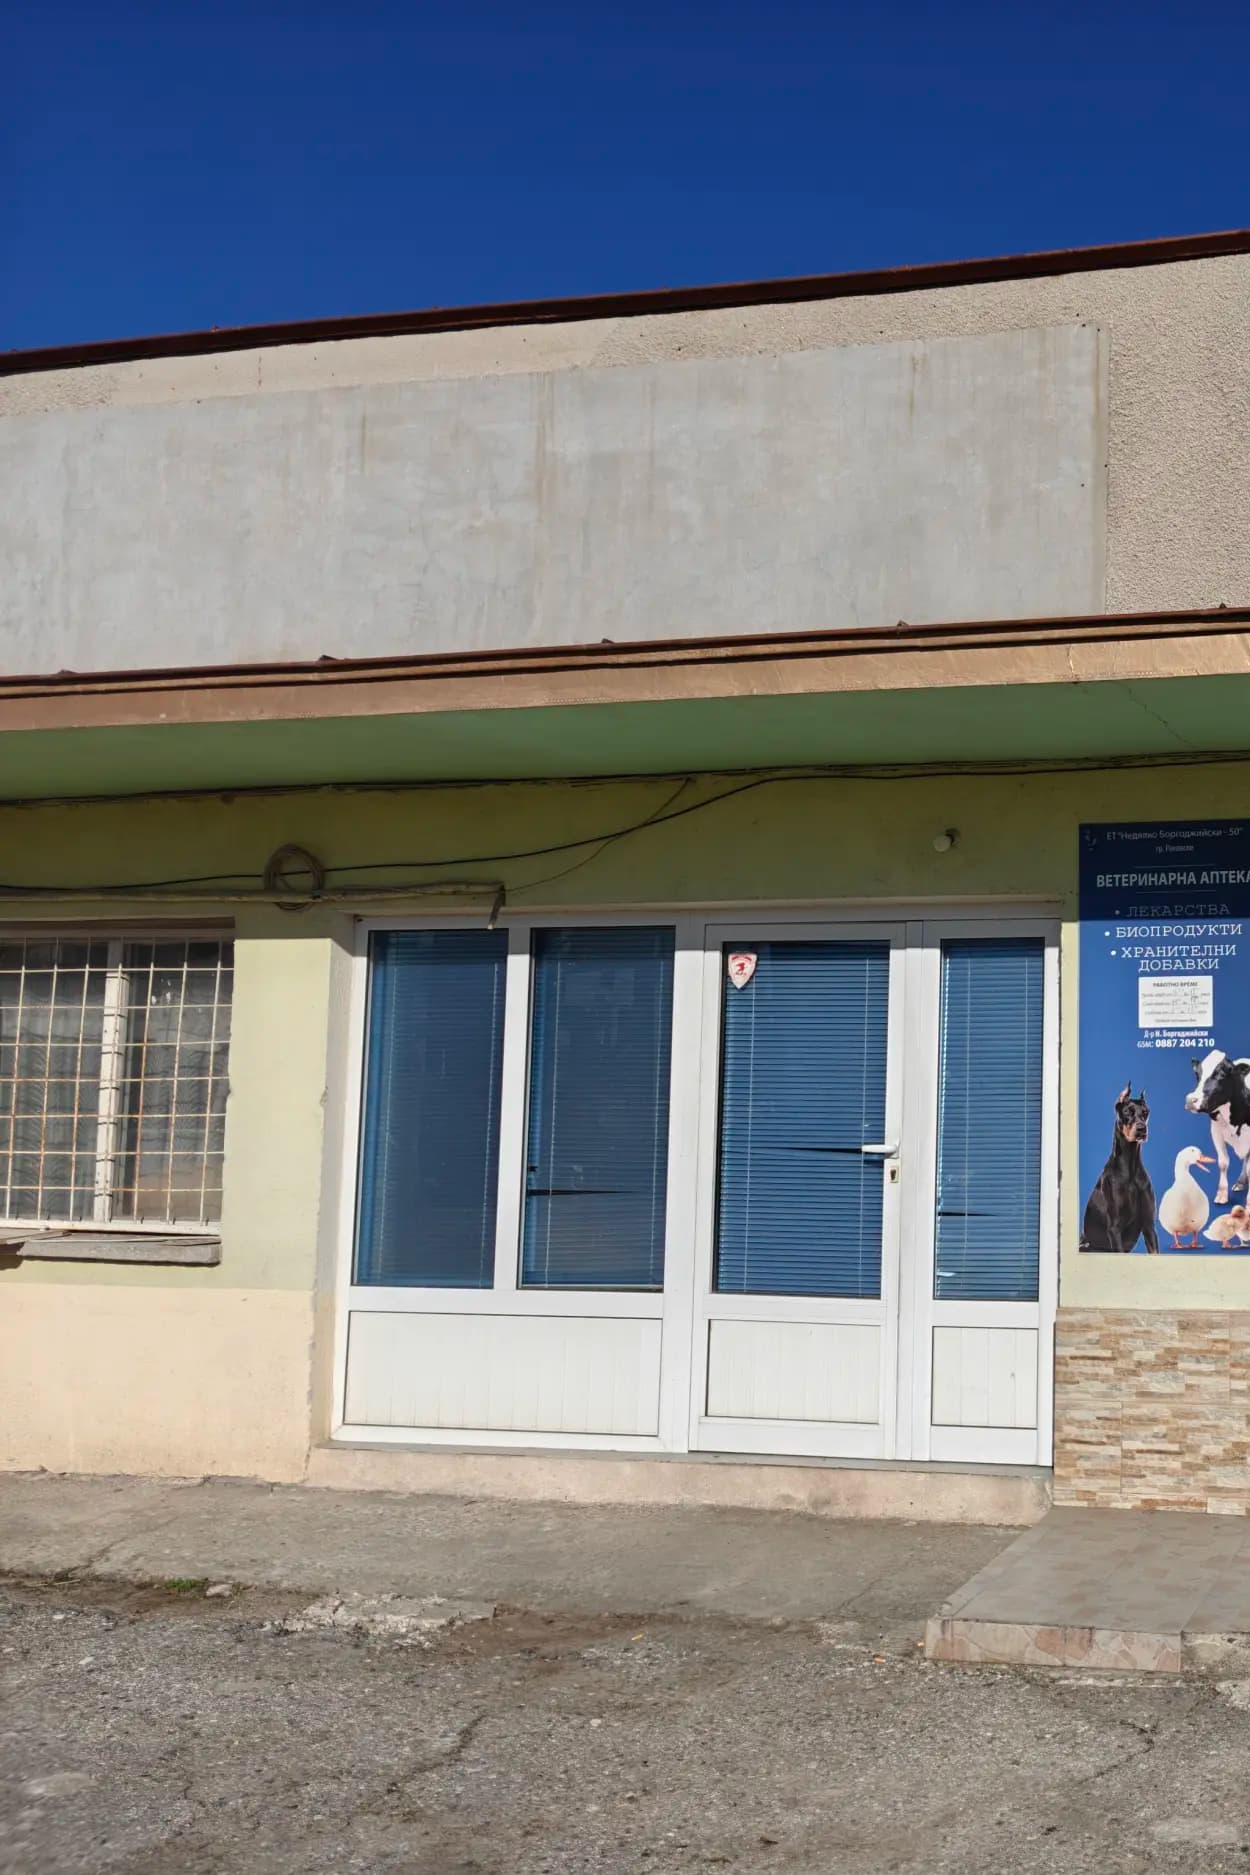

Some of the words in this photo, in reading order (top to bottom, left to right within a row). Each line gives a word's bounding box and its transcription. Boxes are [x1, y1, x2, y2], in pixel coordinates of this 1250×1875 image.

[1096, 871, 1197, 888] ВЕТЕРИНАРНА
[1126, 903, 1231, 918] ЛЕКАРСТВА
[1115, 923, 1243, 938] БИОПРОДУКТИ
[1120, 944, 1237, 958] ХРАНИТЕЛНИ
[1138, 958, 1220, 973] ДОБАВКИ
[1155, 1038, 1178, 1048] 0887
[1180, 1038, 1196, 1047] 204
[1198, 1038, 1215, 1047] 210
